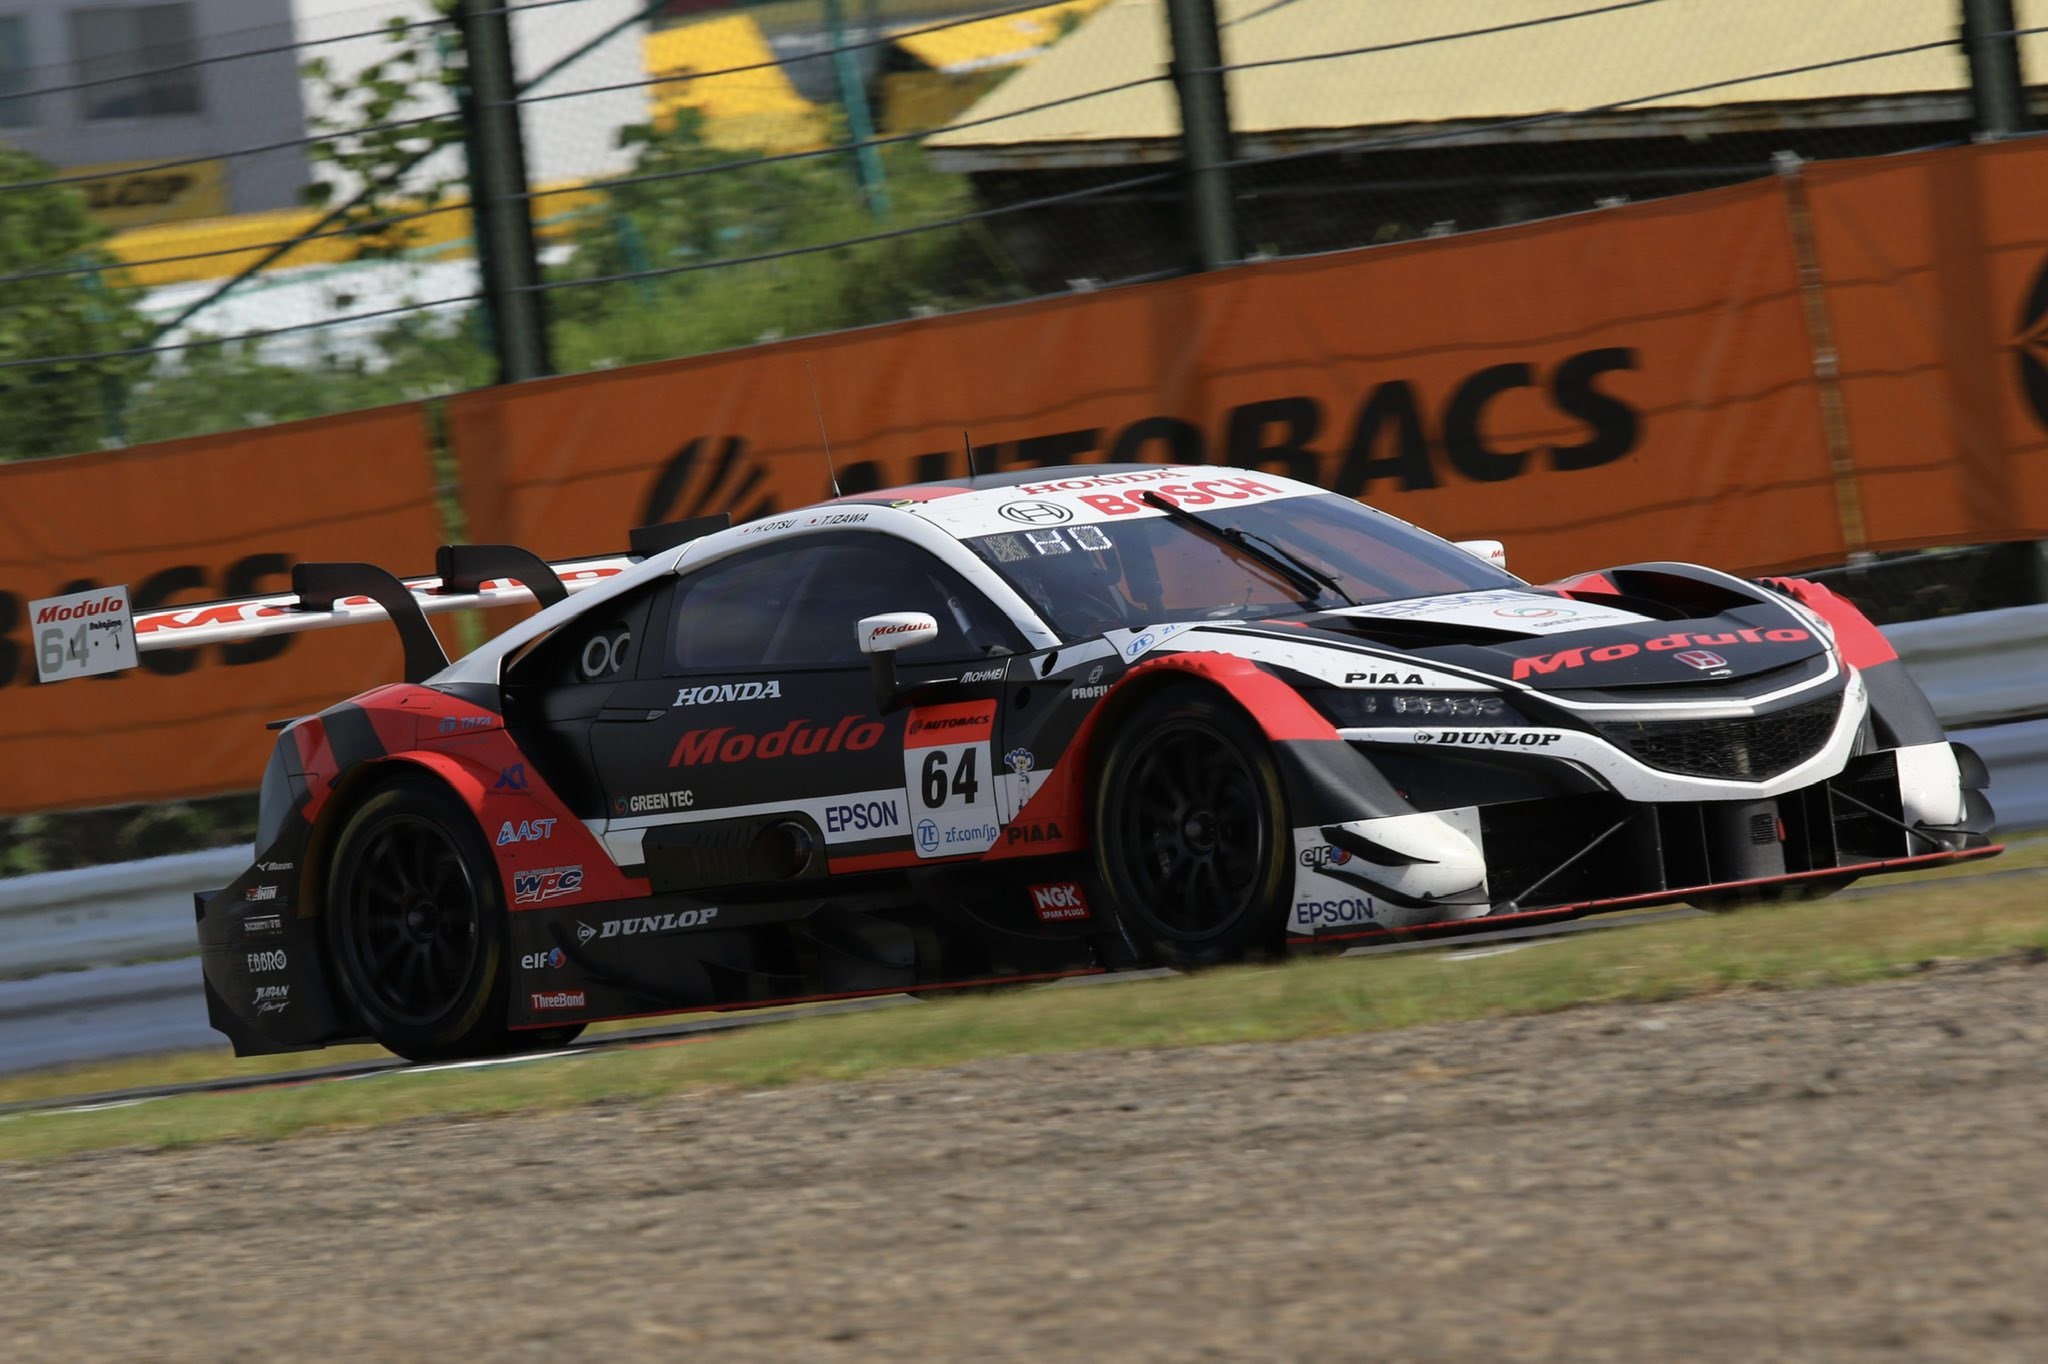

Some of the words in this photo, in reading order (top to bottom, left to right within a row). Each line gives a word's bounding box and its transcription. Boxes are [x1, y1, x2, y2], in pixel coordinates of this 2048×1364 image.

[1018, 470, 1186, 496] HONDA
[1080, 477, 1285, 516] BOSCH
[36, 596, 123, 625] Modulo
[872, 622, 933, 637] Modulo
[40, 622, 91, 675] 64
[1512, 626, 1810, 681] Modulo
[1344, 672, 1425, 686] PIAA
[672, 680, 782, 707] HONDA
[923, 715, 990, 731] AUTOBACS
[668, 715, 886, 768] Modulo
[1437, 731, 1561, 746] DUNLOP
[920, 747, 979, 809] 64
[629, 794, 669, 813] GREEN
[670, 790, 694, 808] TEC
[825, 800, 899, 834] EPSON
[496, 818, 558, 846] AAST
[944, 824, 998, 844] zf.com/jp
[1007, 821, 1063, 846] PIAA
[1300, 845, 1332, 867] elf
[1034, 885, 1081, 909] NGK
[599, 907, 718, 939] DUNLOP
[1064, 908, 1085, 917] PLUGS
[1296, 898, 1374, 924] EPSON
[247, 949, 287, 973] EBBRO
[521, 952, 548, 969] elf
[532, 992, 585, 1008] ThreeBond
